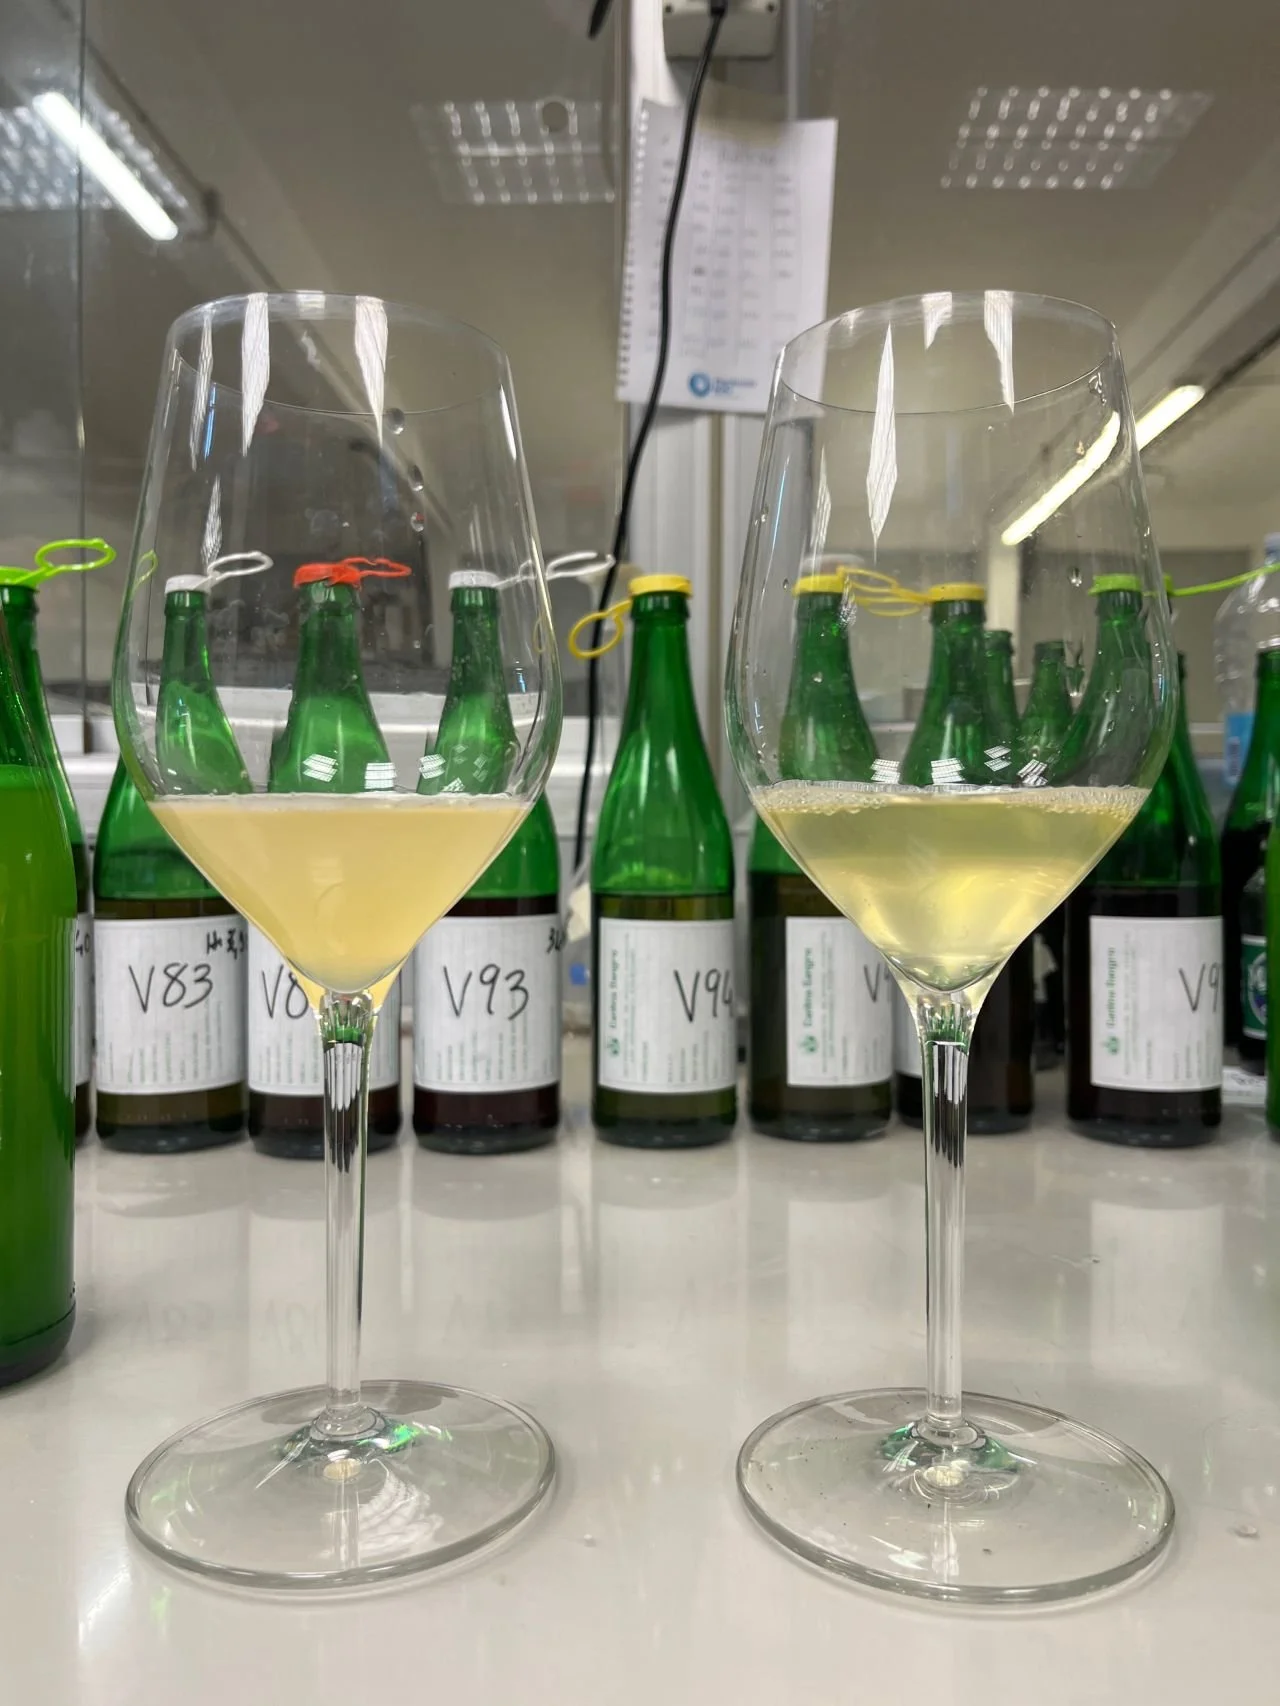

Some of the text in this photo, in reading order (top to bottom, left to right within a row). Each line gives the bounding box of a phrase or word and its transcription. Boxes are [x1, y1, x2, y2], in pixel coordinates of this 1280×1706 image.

[128, 962, 214, 1014] V83
[261, 963, 310, 1019] V8
[443, 963, 529, 1020] V93
[673, 967, 734, 1022] V94
